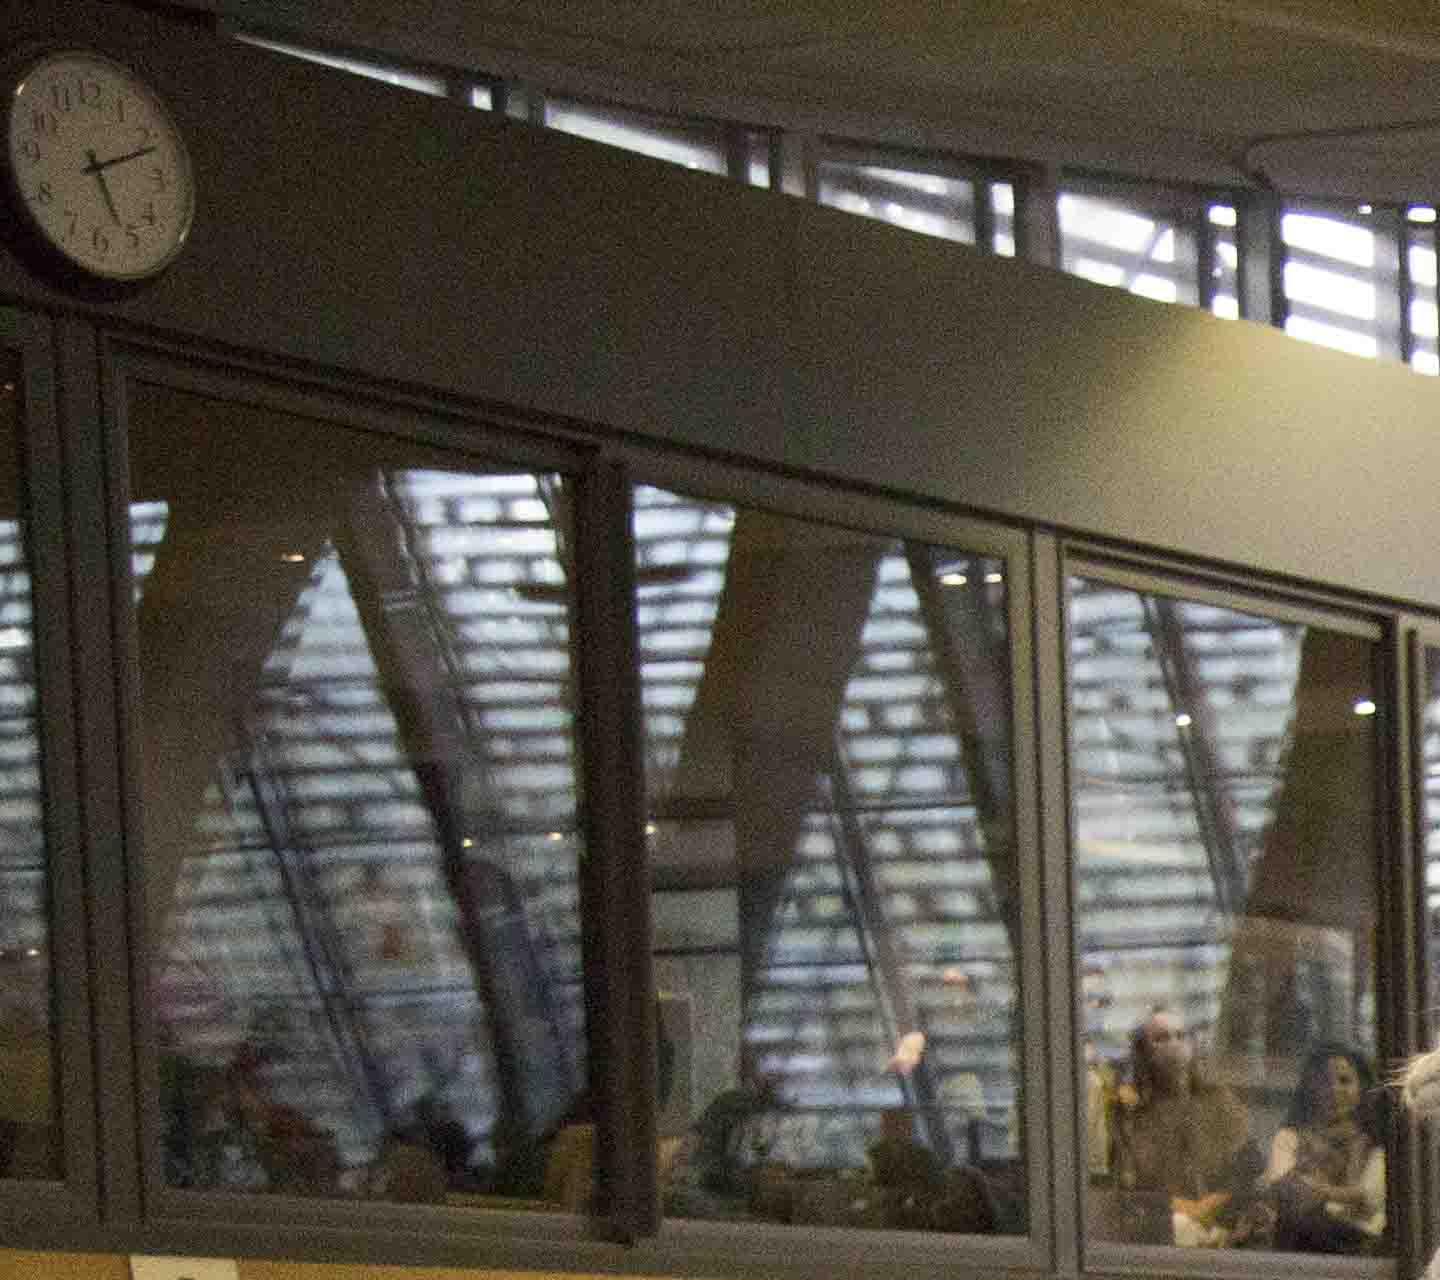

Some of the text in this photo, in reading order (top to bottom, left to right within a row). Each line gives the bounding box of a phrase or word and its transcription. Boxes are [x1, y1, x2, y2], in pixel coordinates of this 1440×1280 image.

[52, 84, 72, 111] 11
[78, 79, 103, 110] 12
[38, 181, 53, 205] 8
[150, 168, 166, 192] 3
[141, 200, 156, 226] 4
[92, 226, 109, 252] 6
[124, 223, 143, 249] 5
